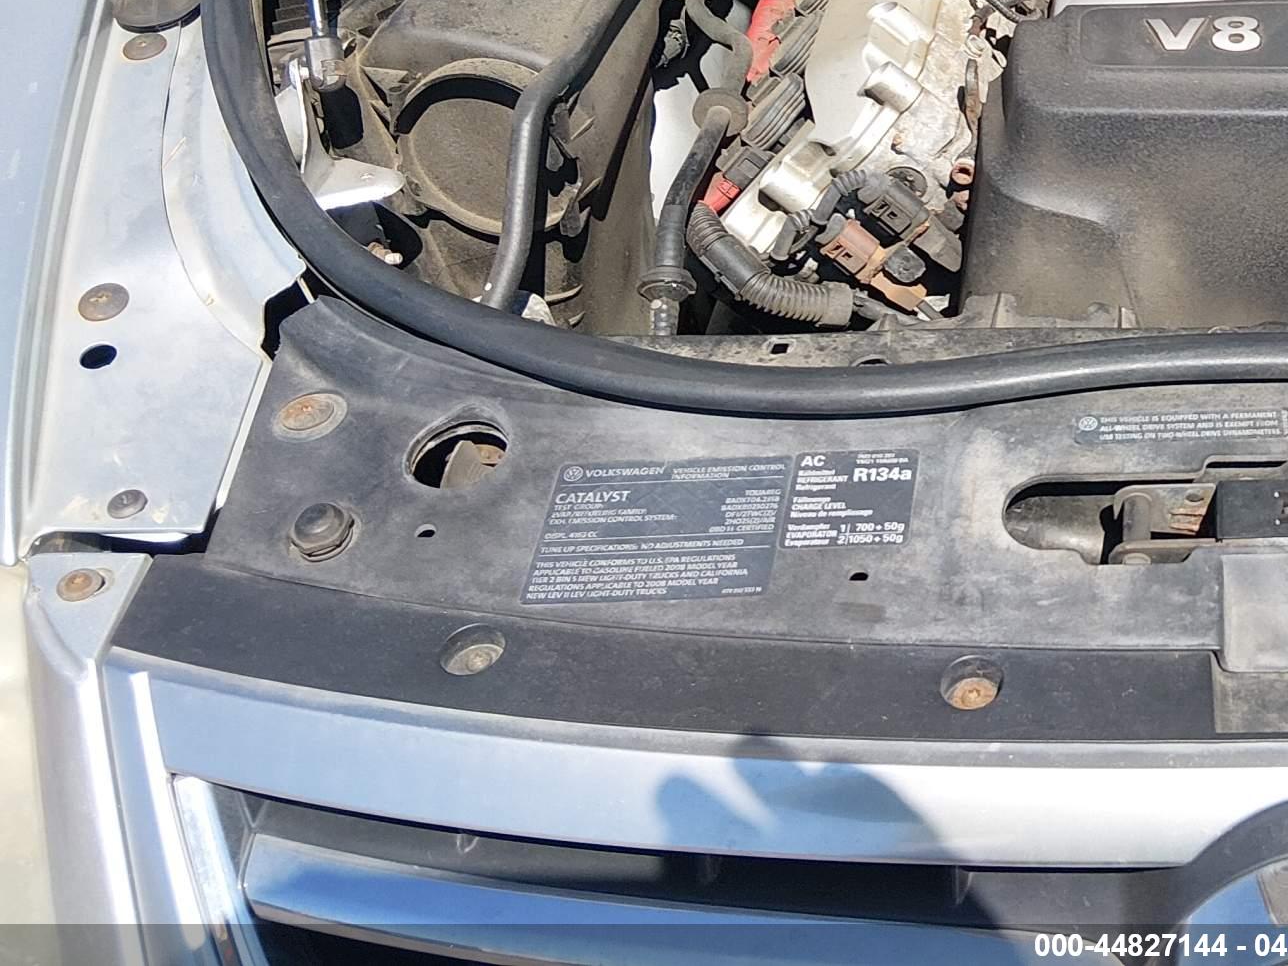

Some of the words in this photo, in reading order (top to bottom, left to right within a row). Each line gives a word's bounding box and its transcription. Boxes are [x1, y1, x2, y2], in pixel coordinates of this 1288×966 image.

[1146, 16, 1262, 52] V8
[800, 455, 826, 467] AC
[585, 466, 666, 477] VOLKSWAGEN
[707, 465, 747, 473] EMISSION
[853, 467, 912, 482] R134a
[556, 491, 631, 504] CATALYST
[824, 502, 846, 510] LEVEL
[840, 524, 846, 532] 1
[856, 522, 875, 531] 700
[655, 540, 711, 549] ADJUSTMENTS
[837, 536, 845, 544] 2
[849, 535, 873, 544] 1050
[681, 554, 736, 563] REGULATIONS
[533, 568, 581, 576] APPLICABLE
[592, 566, 633, 574] GASOLINE
[648, 572, 680, 580] TRUCKS
[700, 569, 749, 577] CALIFORNIA
[528, 584, 585, 592] REGULATIONS
[585, 581, 633, 590] APPLICABLE
[586, 589, 635, 598] LIGHT-DUTY
[636, 587, 668, 595] TRUCKS
